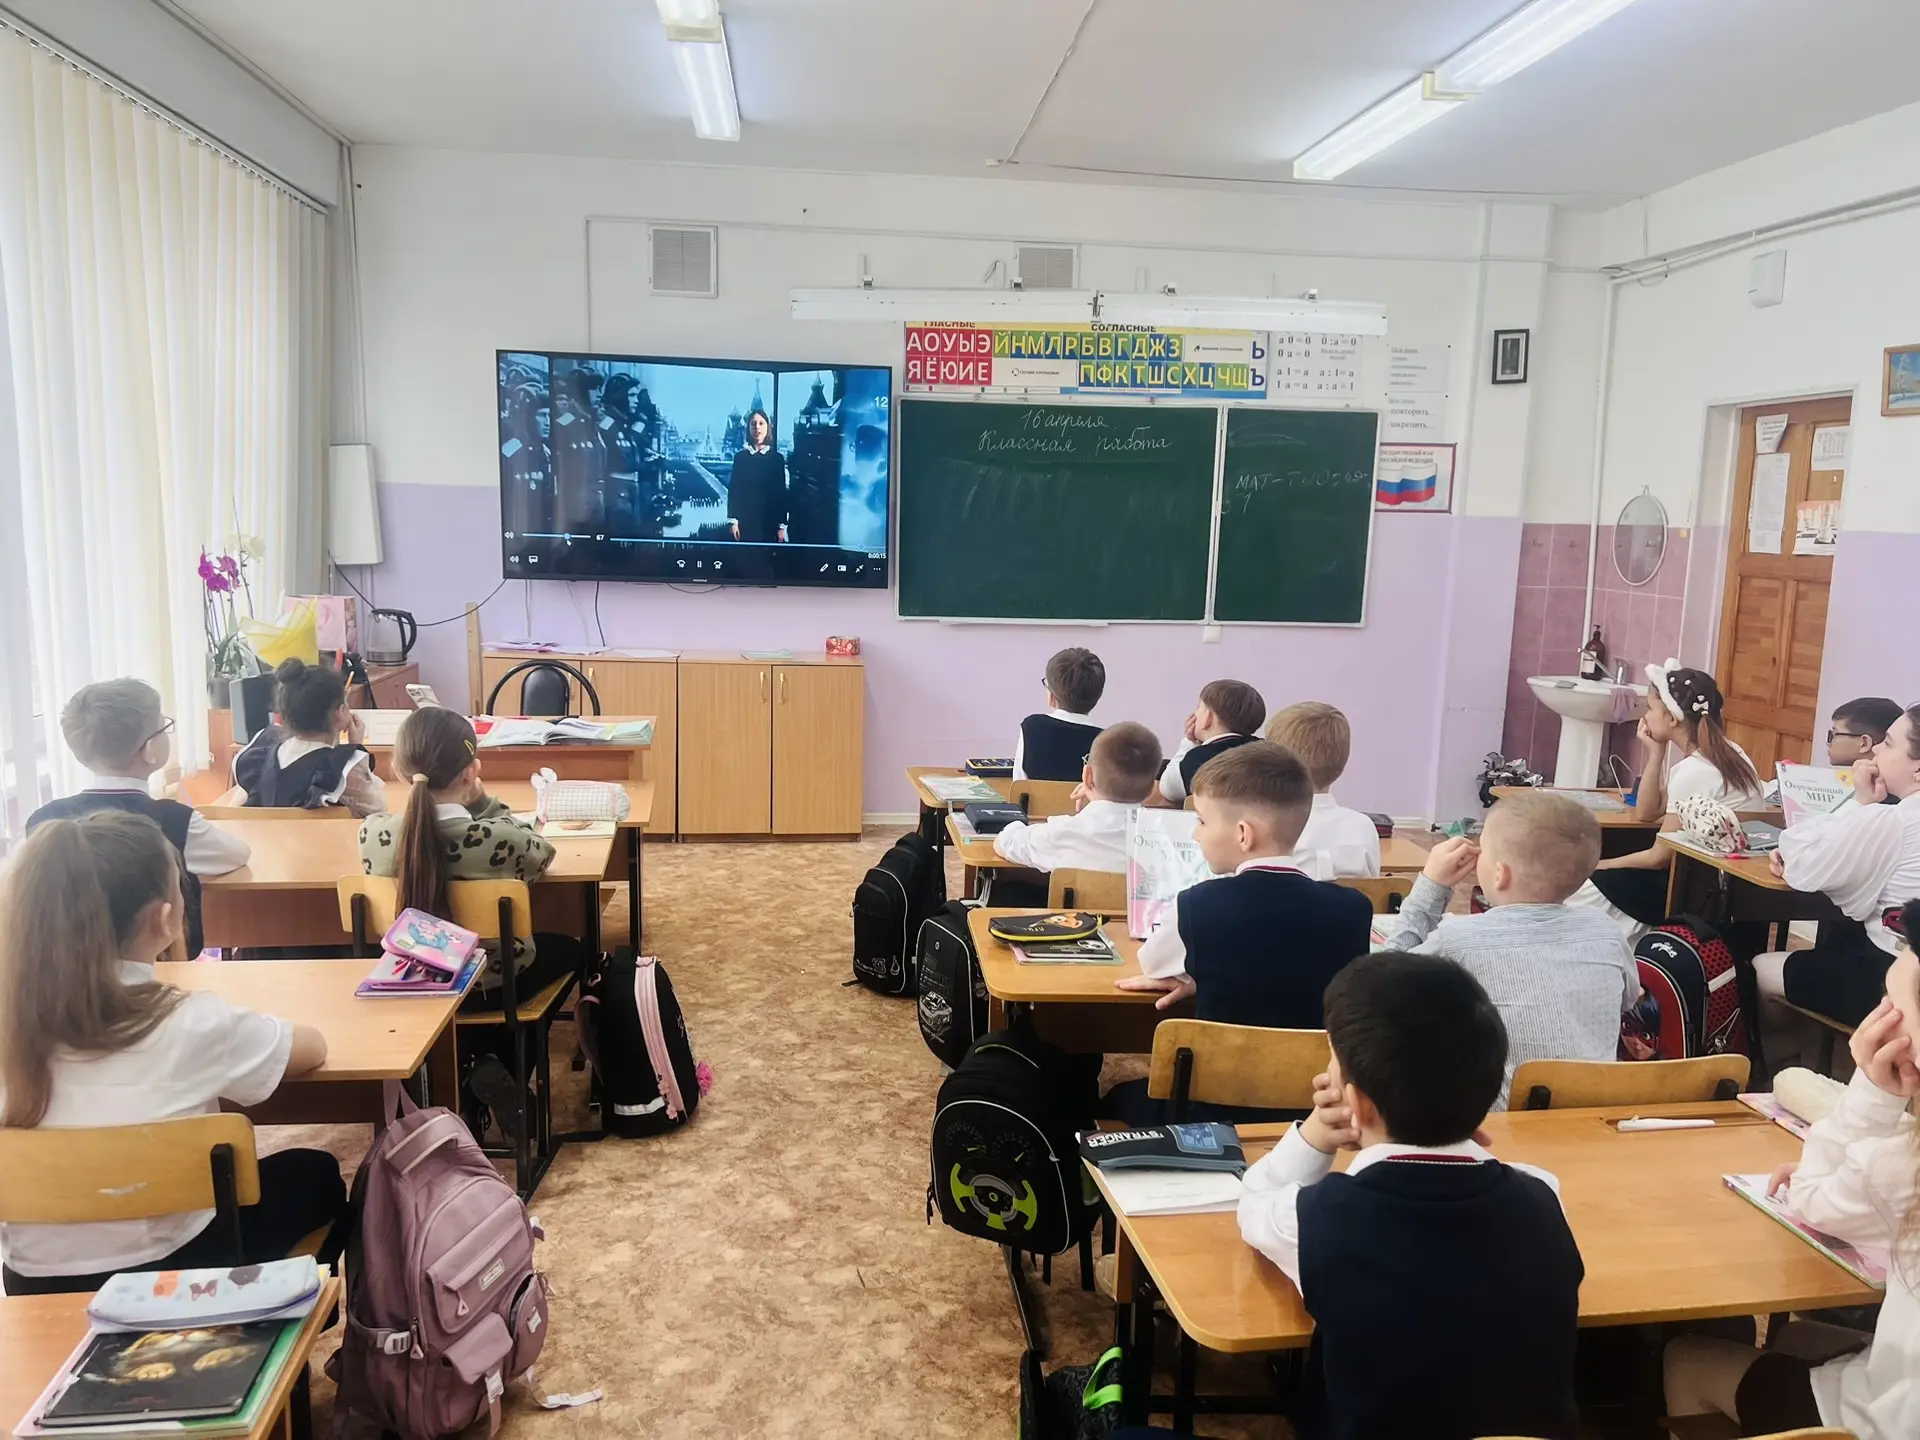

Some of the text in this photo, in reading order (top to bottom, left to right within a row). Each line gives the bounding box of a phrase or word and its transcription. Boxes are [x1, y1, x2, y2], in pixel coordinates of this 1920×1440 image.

[1021, 408, 1109, 438] 16 апреля
[978, 425, 1172, 456] Классная работа
